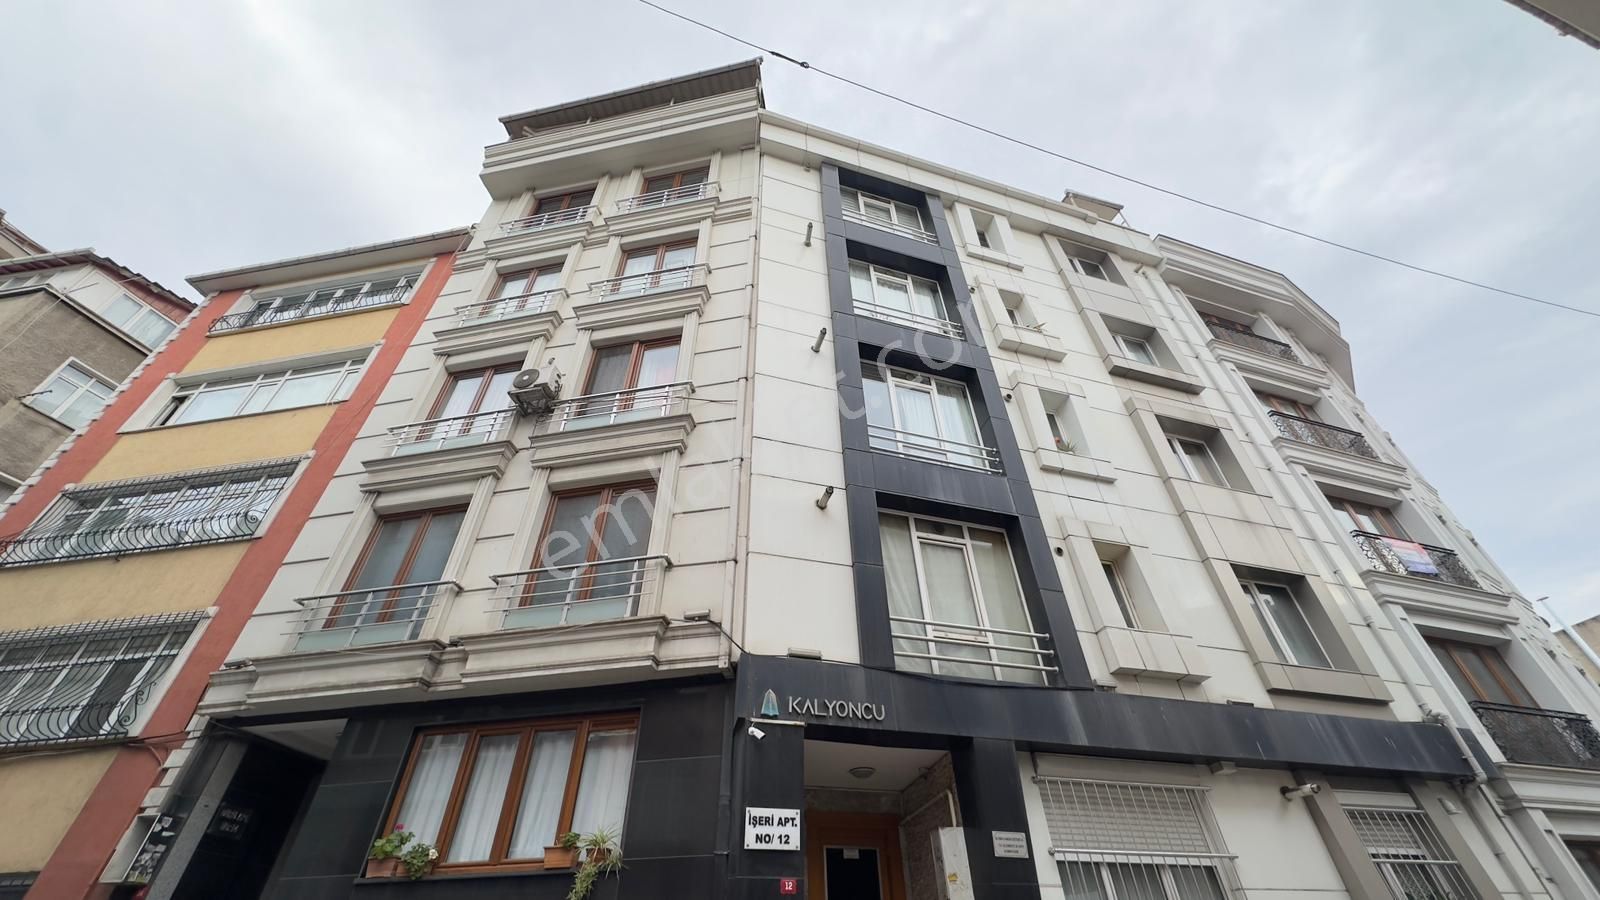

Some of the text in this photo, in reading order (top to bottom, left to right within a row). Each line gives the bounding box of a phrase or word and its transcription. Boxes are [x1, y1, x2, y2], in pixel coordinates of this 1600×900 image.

[788, 696, 886, 721] KALYONCU
[748, 812, 798, 829] İŞERİ APT.
[755, 833, 791, 845] NO/ 12
[784, 881, 793, 890] 12
